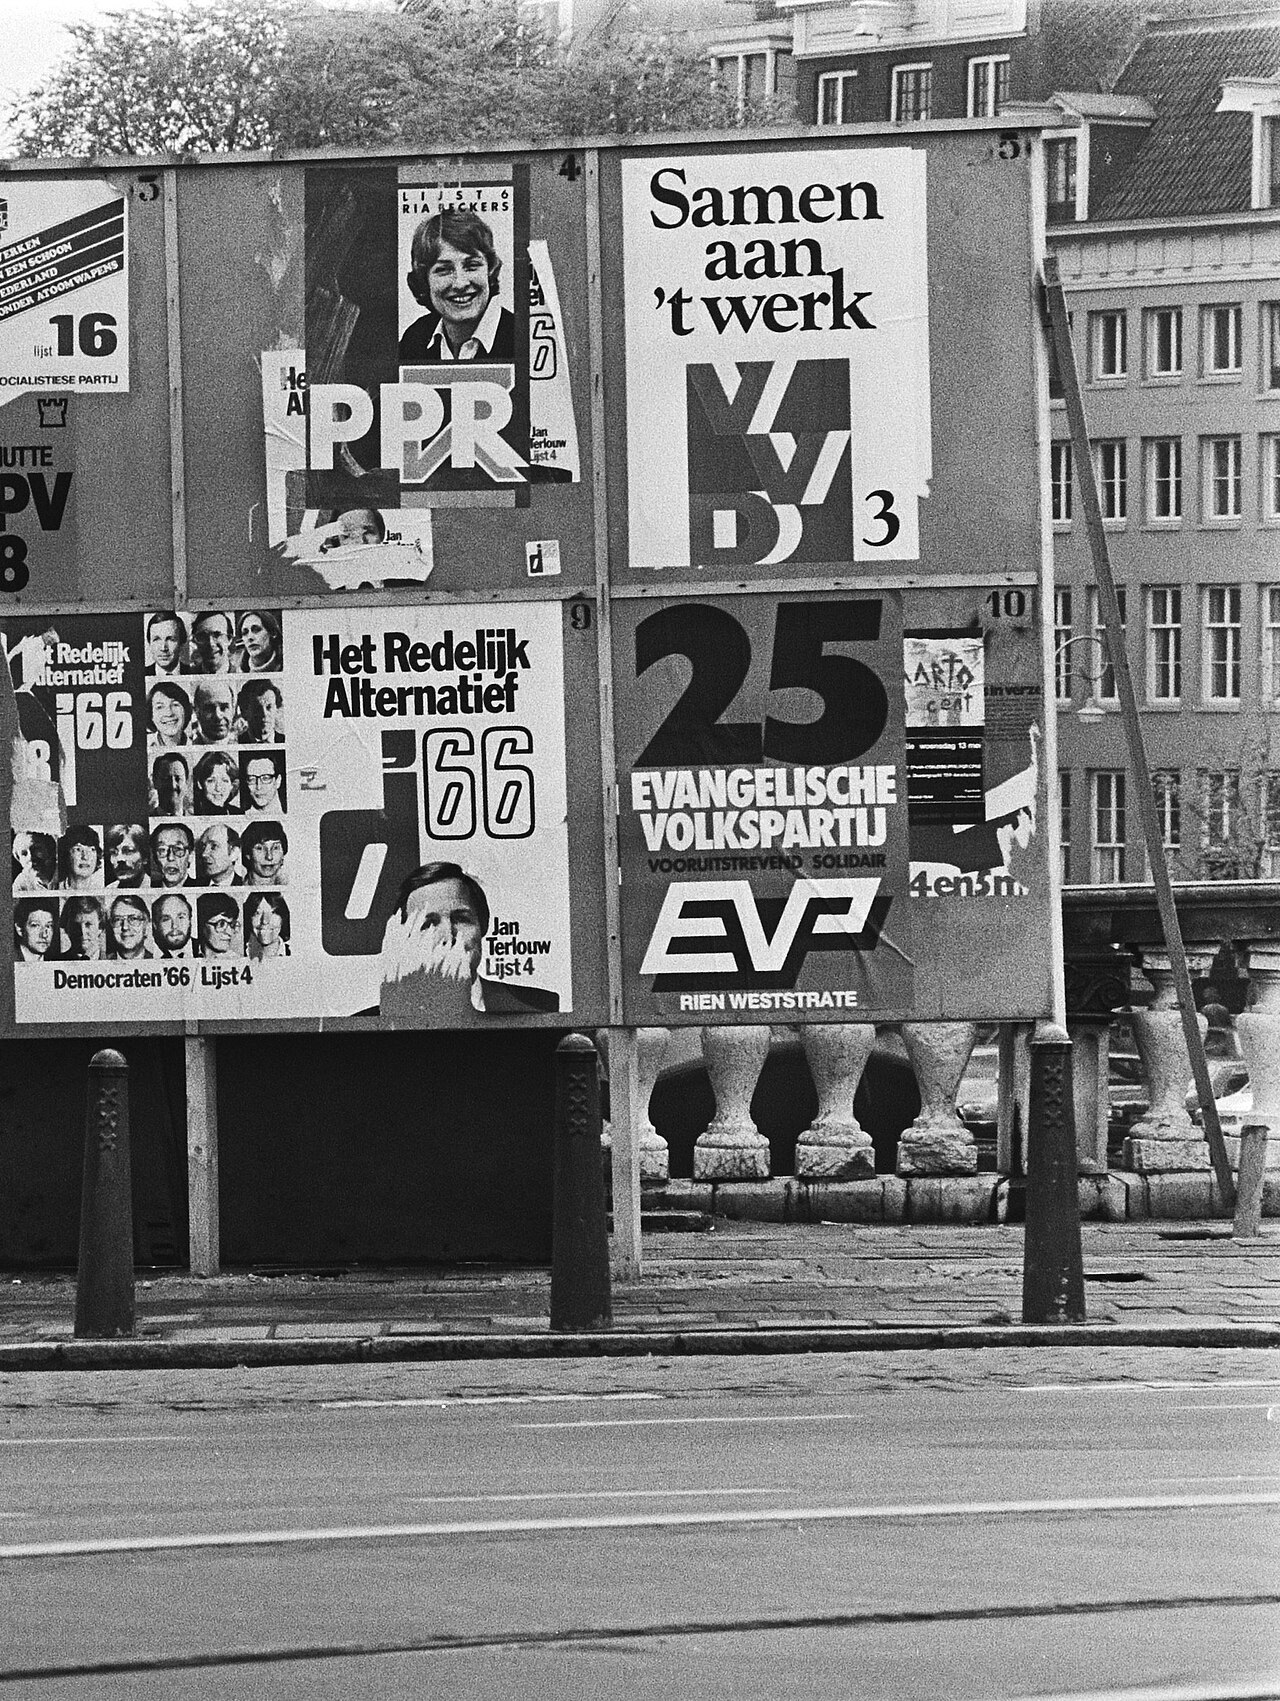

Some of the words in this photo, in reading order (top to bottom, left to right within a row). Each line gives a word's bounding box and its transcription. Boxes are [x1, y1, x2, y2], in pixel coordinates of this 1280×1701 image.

[999, 131, 1020, 159] 5
[559, 154, 581, 181] 4
[402, 190, 482, 201] LIJST
[501, 189, 509, 199] 6
[402, 203, 430, 214] RIA
[650, 168, 884, 229] Samen
[6, 260, 28, 277] EEN
[28, 242, 72, 267] SCHOON
[704, 237, 827, 281] aan
[37, 260, 119, 301] ATOOMWAPENS
[700, 268, 878, 335] werk
[34, 344, 53, 358] lijst
[49, 313, 118, 357] 16
[78, 374, 118, 385] PARTIJ
[308, 382, 530, 470] PPR
[531, 427, 548, 437] Jan
[550, 449, 557, 460] 4
[686, 358, 855, 567] VVD
[862, 489, 901, 547] 3
[386, 530, 402, 541] Jan
[571, 604, 591, 630] 9
[986, 590, 1026, 617] 10
[57, 642, 131, 667] Redelijk
[312, 633, 377, 676] Het
[383, 628, 531, 678] Redelijk
[324, 673, 519, 719] Alternatief
[633, 599, 889, 768] 25
[631, 765, 897, 811] EVANGELISCHE
[640, 808, 887, 851] VOLKSPARTIJ
[648, 854, 803, 873] VOORUITSTREVEND
[812, 854, 888, 869] SOLIDAIR
[933, 875, 973, 897] en
[492, 917, 519, 935] Jan
[639, 878, 883, 978] EVP
[486, 937, 551, 955] Terlouw
[53, 969, 162, 989] Democraten
[201, 966, 239, 989] Lijst
[240, 965, 253, 985] 4
[486, 957, 521, 980] Lijst
[523, 957, 535, 975] 4
[680, 994, 725, 1011] RIEN
[729, 991, 858, 1010] WESTSTRATE
